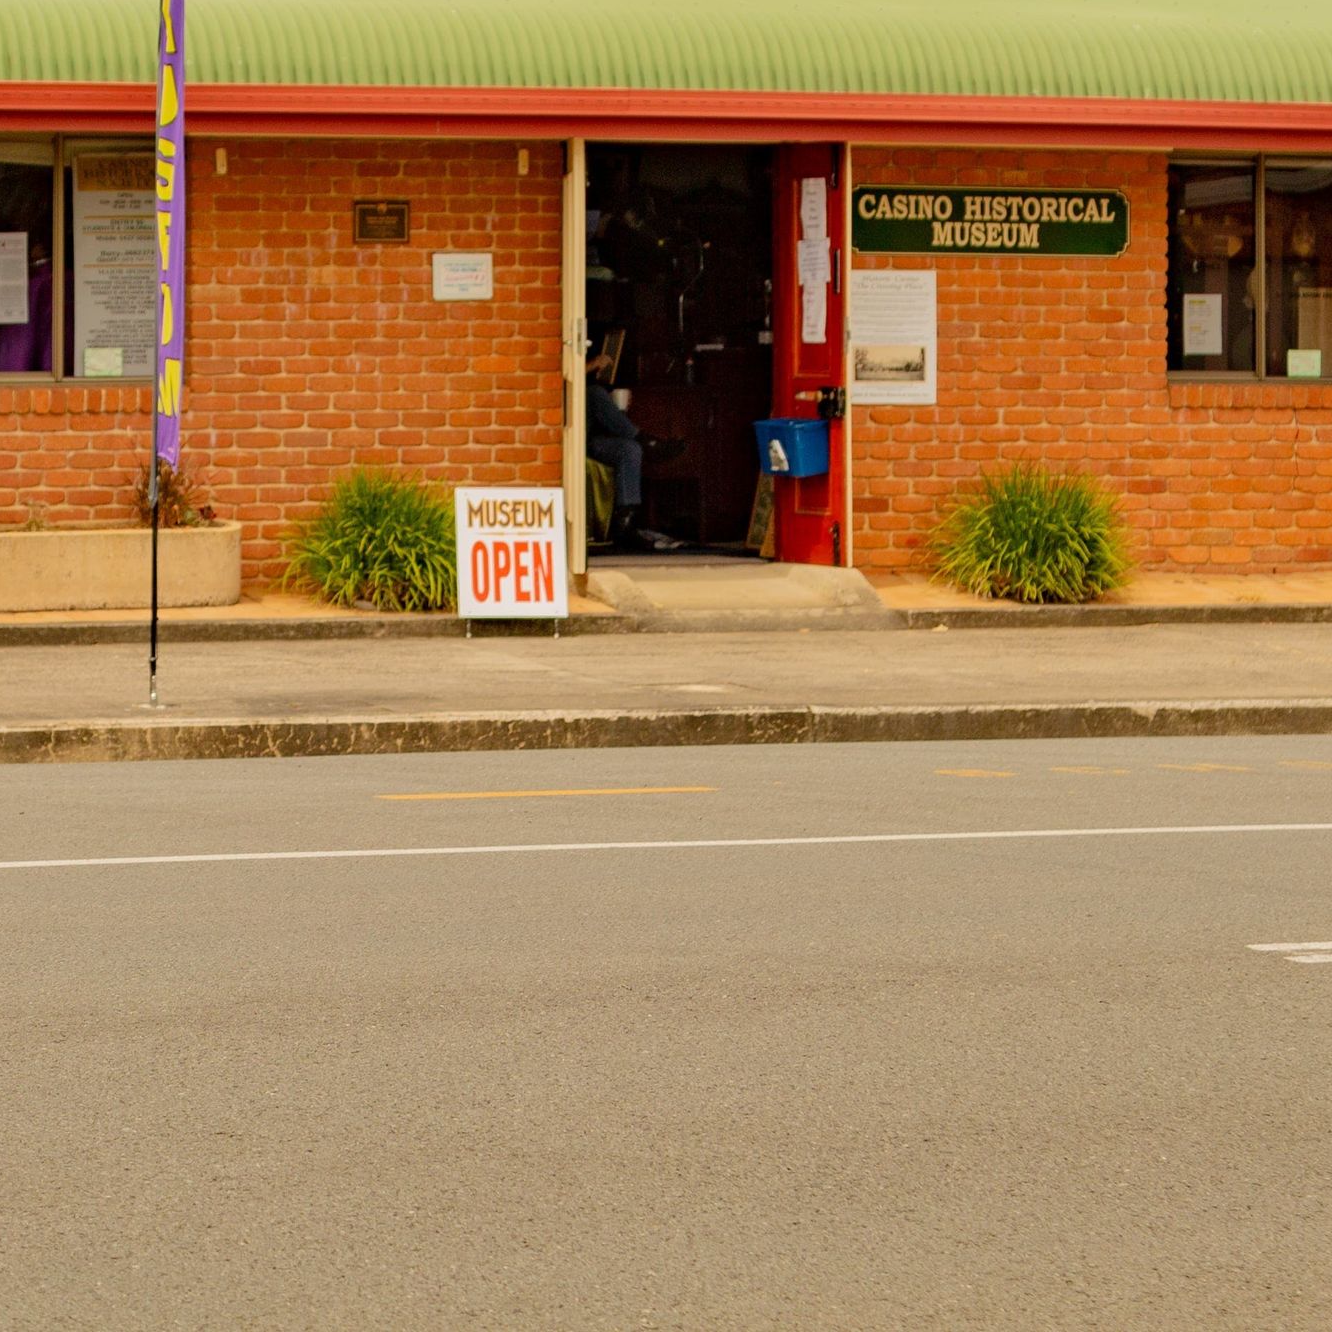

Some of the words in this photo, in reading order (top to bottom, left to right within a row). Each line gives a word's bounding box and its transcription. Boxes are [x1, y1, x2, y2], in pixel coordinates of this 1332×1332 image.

[858, 194, 953, 219] CASINO
[964, 196, 1116, 223] HISTORICAL
[931, 221, 1041, 248] MUSEUM
[467, 499, 555, 528] MUSEUM
[471, 540, 555, 603] OPEN
